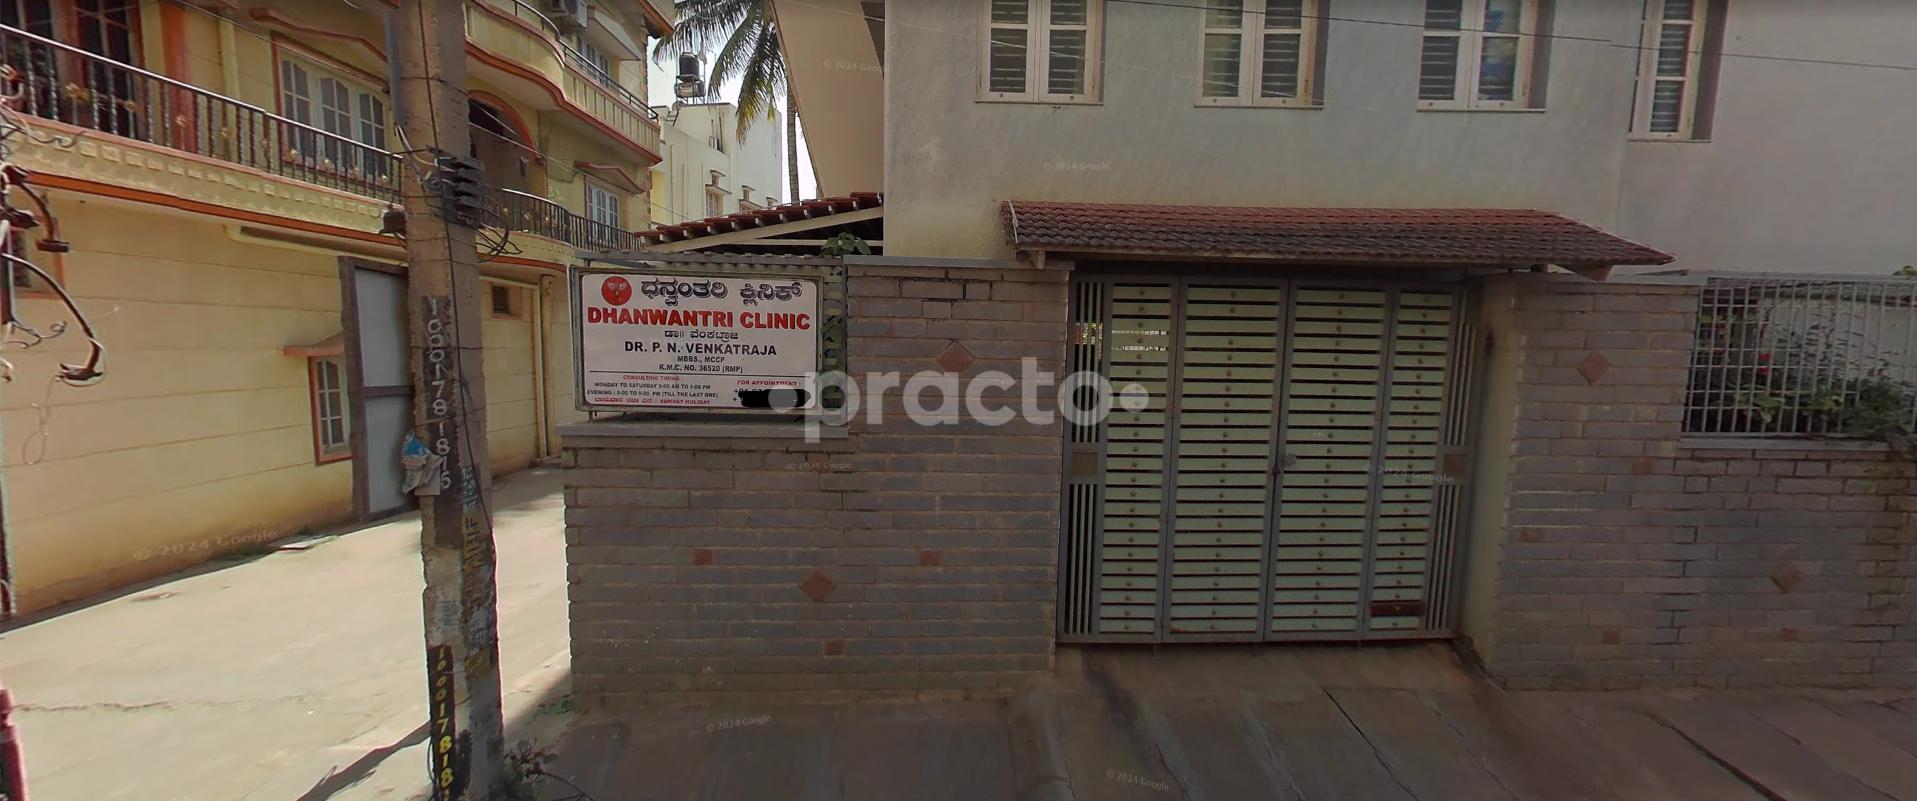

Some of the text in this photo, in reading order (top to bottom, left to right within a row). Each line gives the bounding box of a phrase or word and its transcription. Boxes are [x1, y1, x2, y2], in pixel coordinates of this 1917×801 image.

[641, 277, 803, 307] ಧನ್ವಂತರಿ ಕ್ಲಿನಿಕ್
[587, 306, 811, 330] DHANWANTRI CLINIC
[624, 341, 777, 356] DR. P. N. VENKATRAJA
[699, 365, 720, 373] 36520
